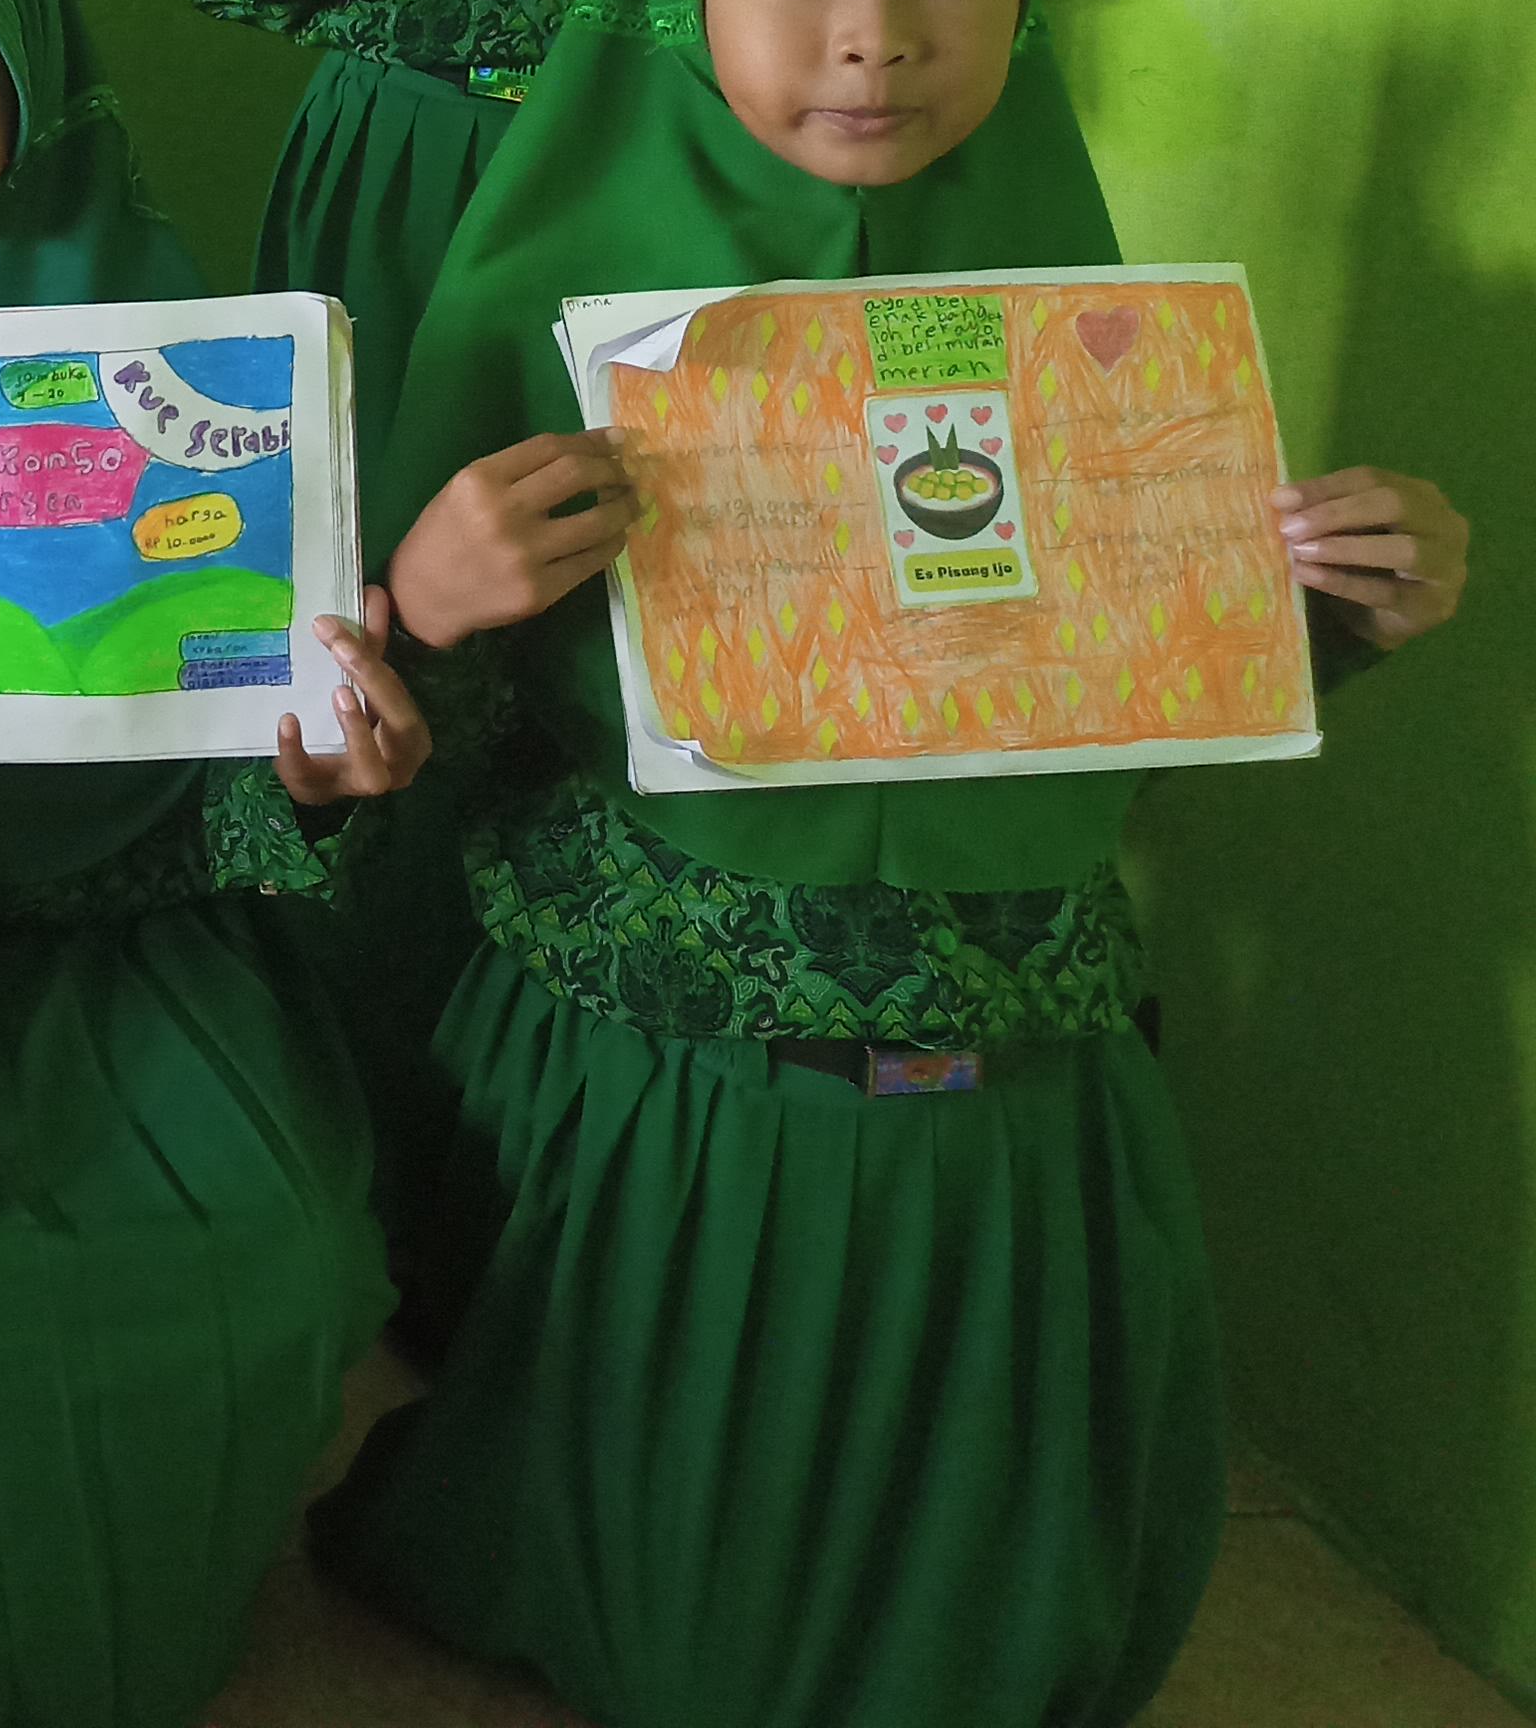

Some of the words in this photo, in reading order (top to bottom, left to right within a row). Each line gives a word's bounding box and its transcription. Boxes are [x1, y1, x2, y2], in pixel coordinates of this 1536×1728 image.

[183, 419, 291, 458] Serabi
[164, 508, 229, 529] harga
[914, 568, 934, 581] Es
[937, 566, 990, 579] Pisang
[991, 561, 1014, 578] Ijo
